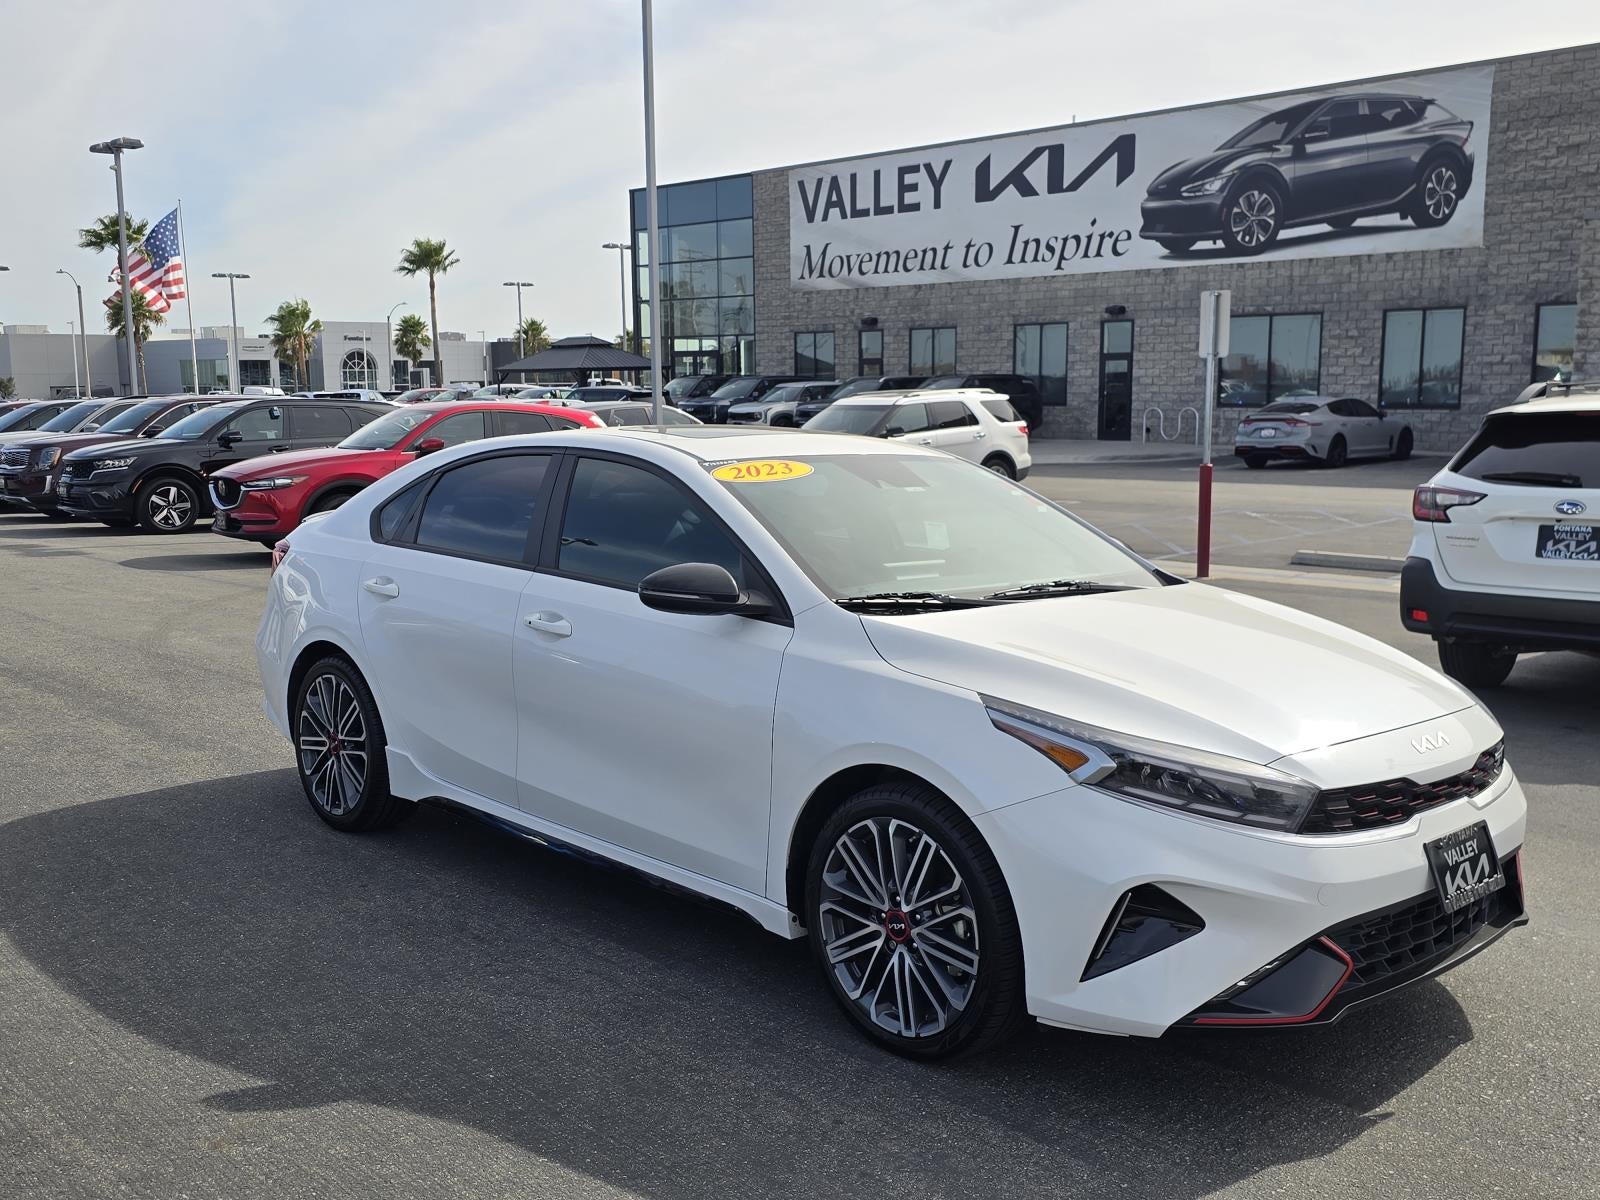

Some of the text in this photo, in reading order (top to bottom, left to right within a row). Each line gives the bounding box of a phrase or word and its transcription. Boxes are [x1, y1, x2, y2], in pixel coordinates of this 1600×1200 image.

[797, 133, 1136, 224] VALLEY KIA
[798, 217, 1132, 281] Movement to Inspire
[729, 463, 793, 479] 2023
[1553, 525, 1593, 533] FONTANA
[1554, 532, 1592, 541] VALLEY
[1541, 549, 1571, 559] VALLEY
[1546, 539, 1598, 553] KIA
[1443, 838, 1479, 867] VALLEY
[1444, 852, 1490, 896] KIA
